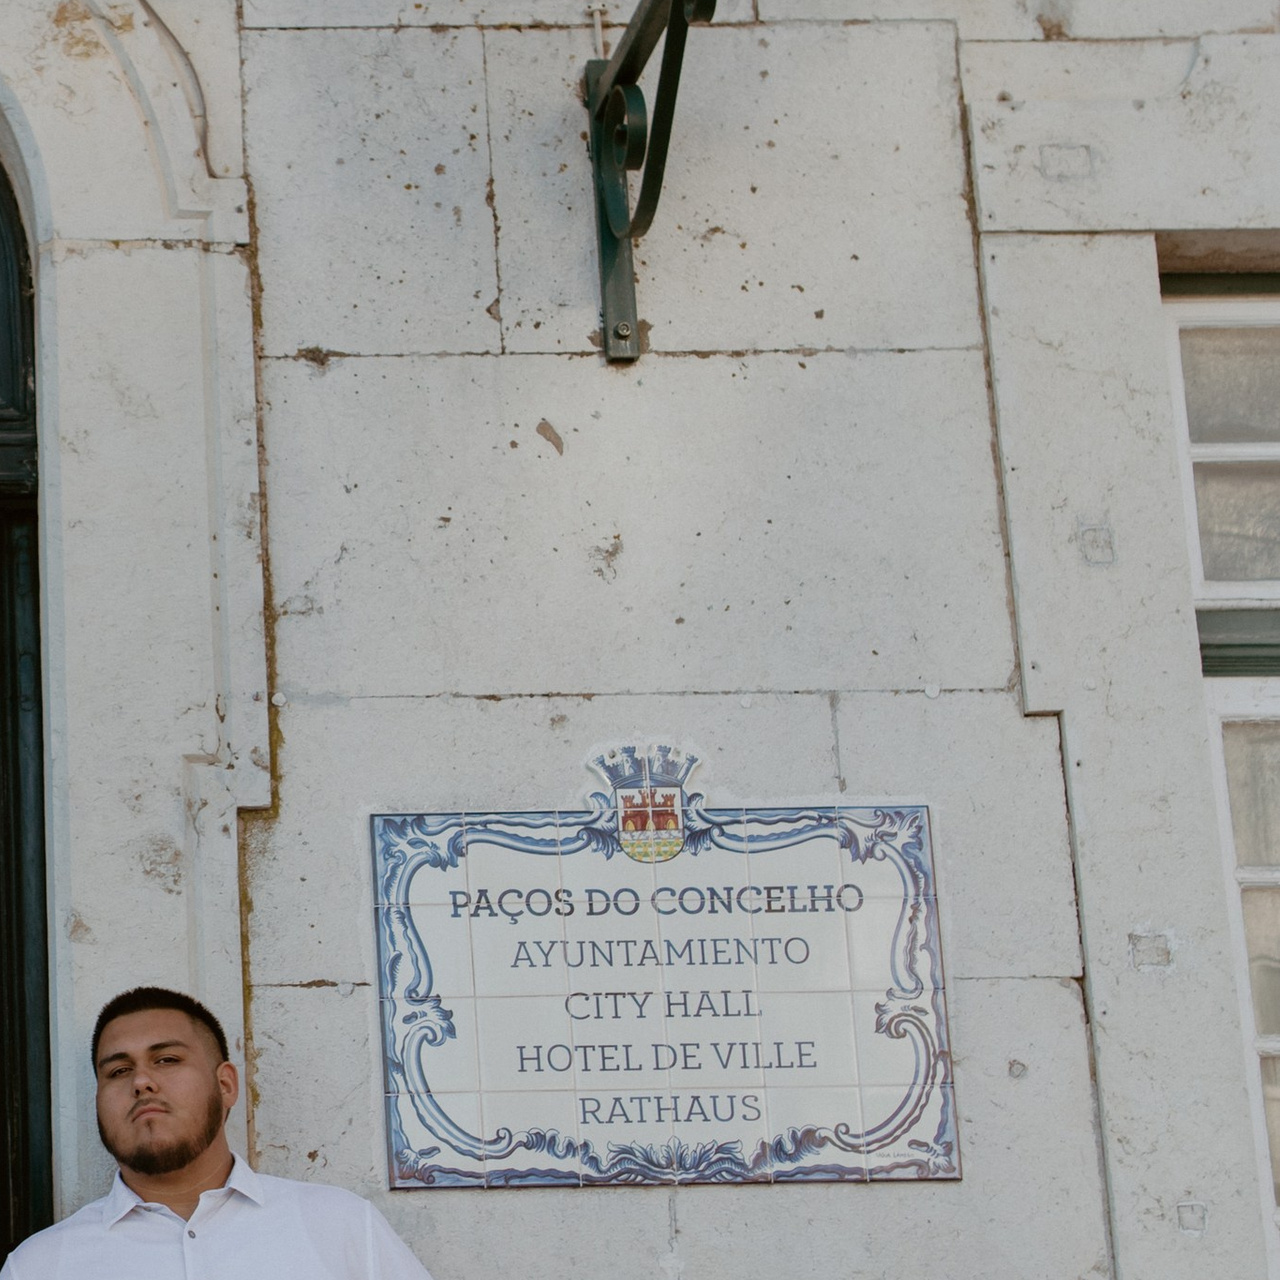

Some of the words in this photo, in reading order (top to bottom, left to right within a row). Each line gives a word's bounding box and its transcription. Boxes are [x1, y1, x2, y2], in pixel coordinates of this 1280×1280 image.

[449, 887, 575, 925] PAÇOS
[585, 886, 641, 916] DO
[650, 883, 865, 916] CONCELHO
[510, 937, 811, 969] AYUNTAMIENTO
[563, 991, 654, 1020] CITY
[663, 989, 763, 1018] HALL
[516, 1044, 643, 1073] HOTEL
[651, 1042, 702, 1071] DE
[709, 1040, 818, 1070] VILLE
[578, 1094, 762, 1125] RATHAUS
